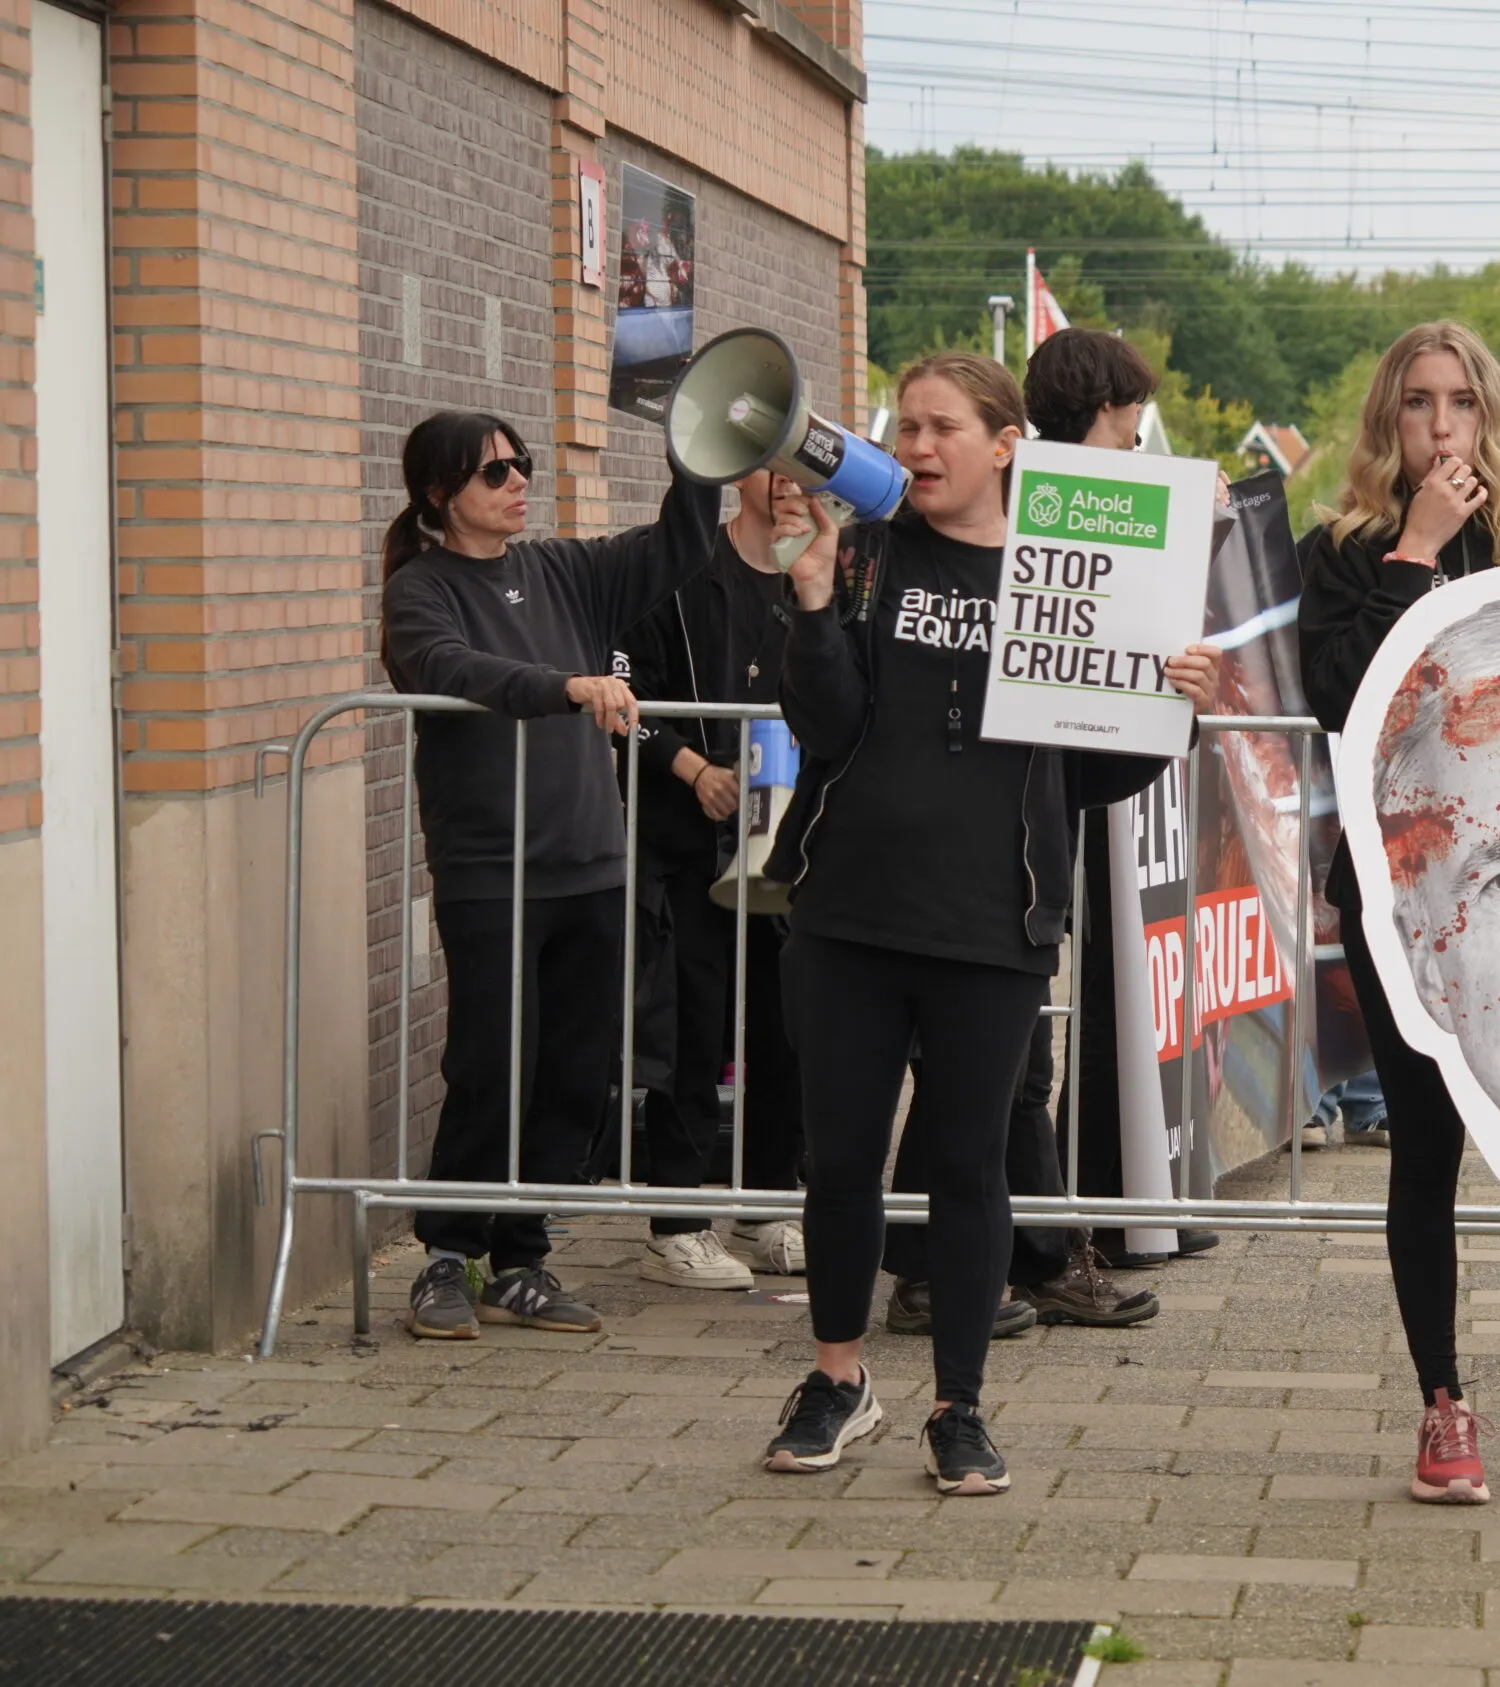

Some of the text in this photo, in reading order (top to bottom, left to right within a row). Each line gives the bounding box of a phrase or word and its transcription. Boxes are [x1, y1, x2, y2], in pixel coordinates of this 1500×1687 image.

[803, 440, 839, 467] EQUALITY
[807, 428, 835, 454] animal
[1070, 489, 1132, 514] Ahold
[1243, 493, 1271, 507] cages
[1068, 511, 1157, 539] Delhaize
[1013, 545, 1112, 591] STOP
[901, 588, 997, 622] anim
[1010, 592, 1096, 638] THIS
[894, 610, 995, 652] EQUA
